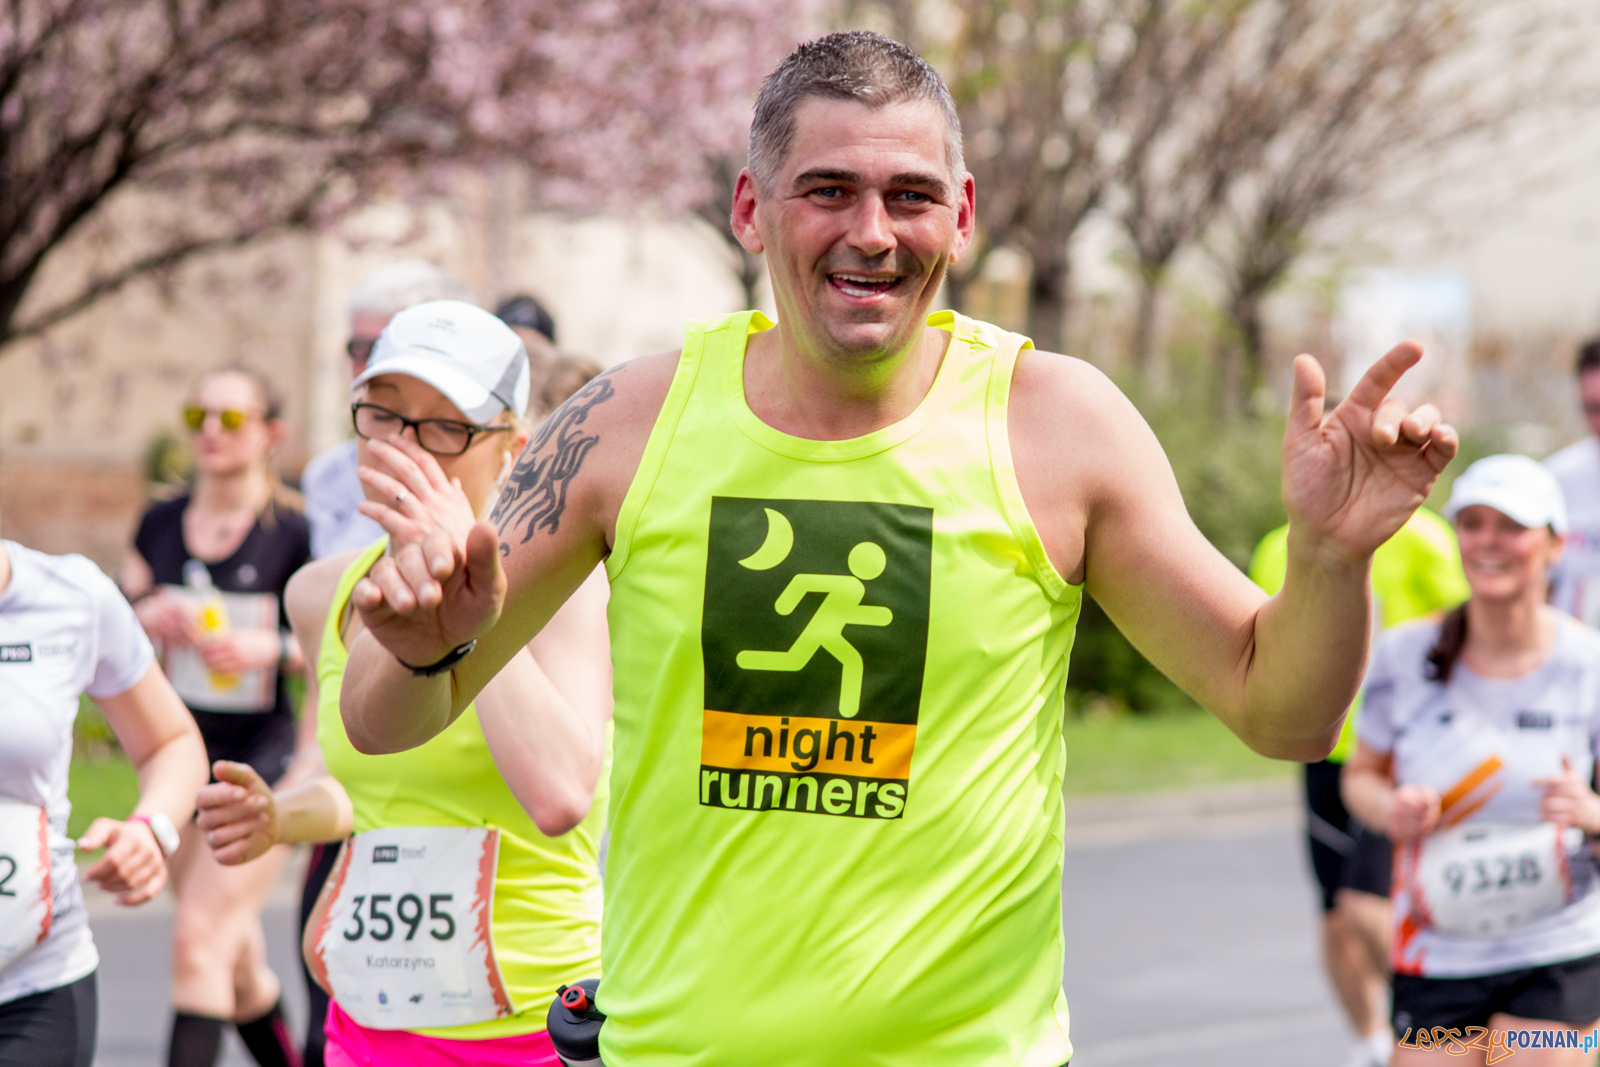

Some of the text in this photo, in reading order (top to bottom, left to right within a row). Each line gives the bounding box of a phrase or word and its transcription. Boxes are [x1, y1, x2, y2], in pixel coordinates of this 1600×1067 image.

[744, 717, 877, 771] night
[701, 769, 905, 818] runners
[1443, 853, 1541, 895] 9328
[343, 892, 456, 942] 3595
[367, 954, 435, 972] Katarzyna
